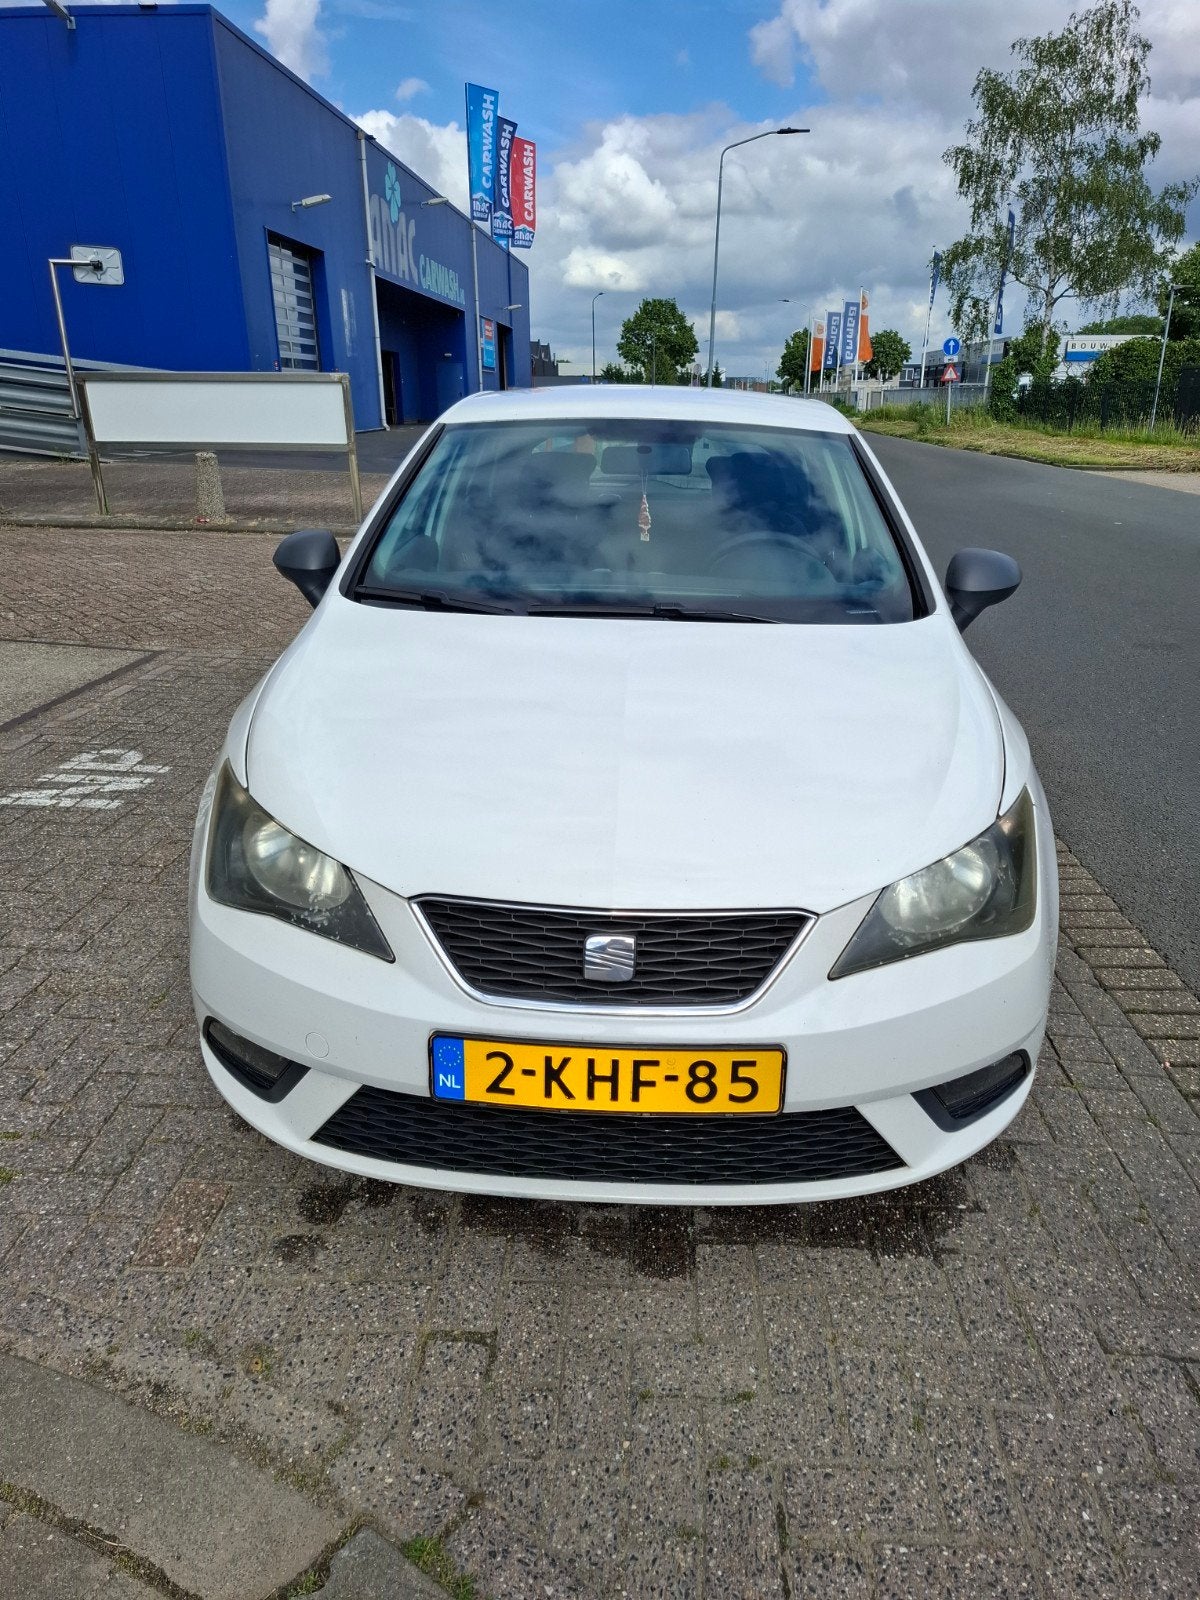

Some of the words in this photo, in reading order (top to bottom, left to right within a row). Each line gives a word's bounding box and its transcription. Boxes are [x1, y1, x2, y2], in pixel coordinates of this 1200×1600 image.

[481, 93, 495, 189] CARWASH
[499, 124, 514, 208] CARWASH
[523, 144, 534, 221] CARWASH
[438, 1073, 461, 1089] NL
[485, 1050, 760, 1104] 2-KHF-85
